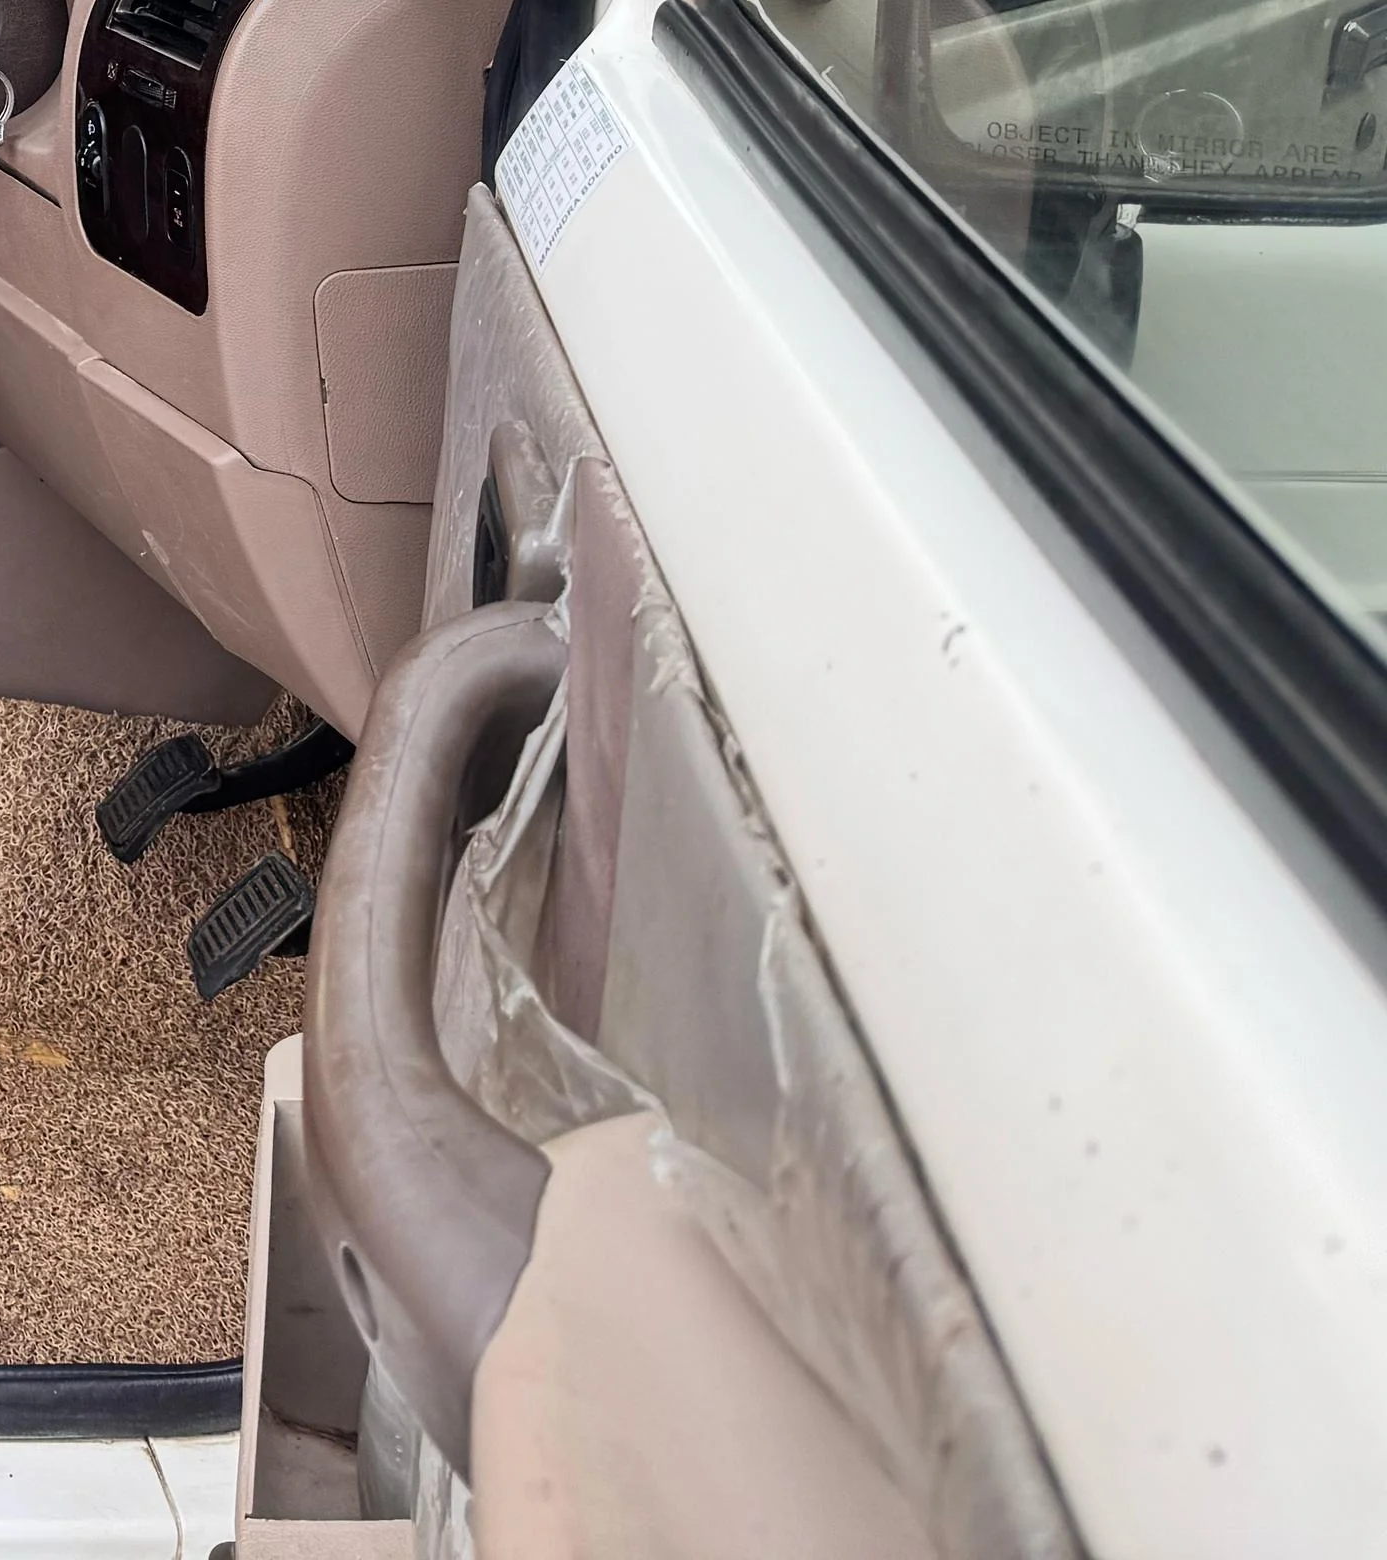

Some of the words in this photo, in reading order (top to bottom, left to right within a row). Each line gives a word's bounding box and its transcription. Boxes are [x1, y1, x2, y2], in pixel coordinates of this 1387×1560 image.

[987, 122, 1088, 145] OBJECT
[1109, 129, 1138, 149] IN
[1157, 133, 1264, 159] MIRROR
[1281, 143, 1339, 165] ARE
[581, 143, 623, 197] BOLERO
